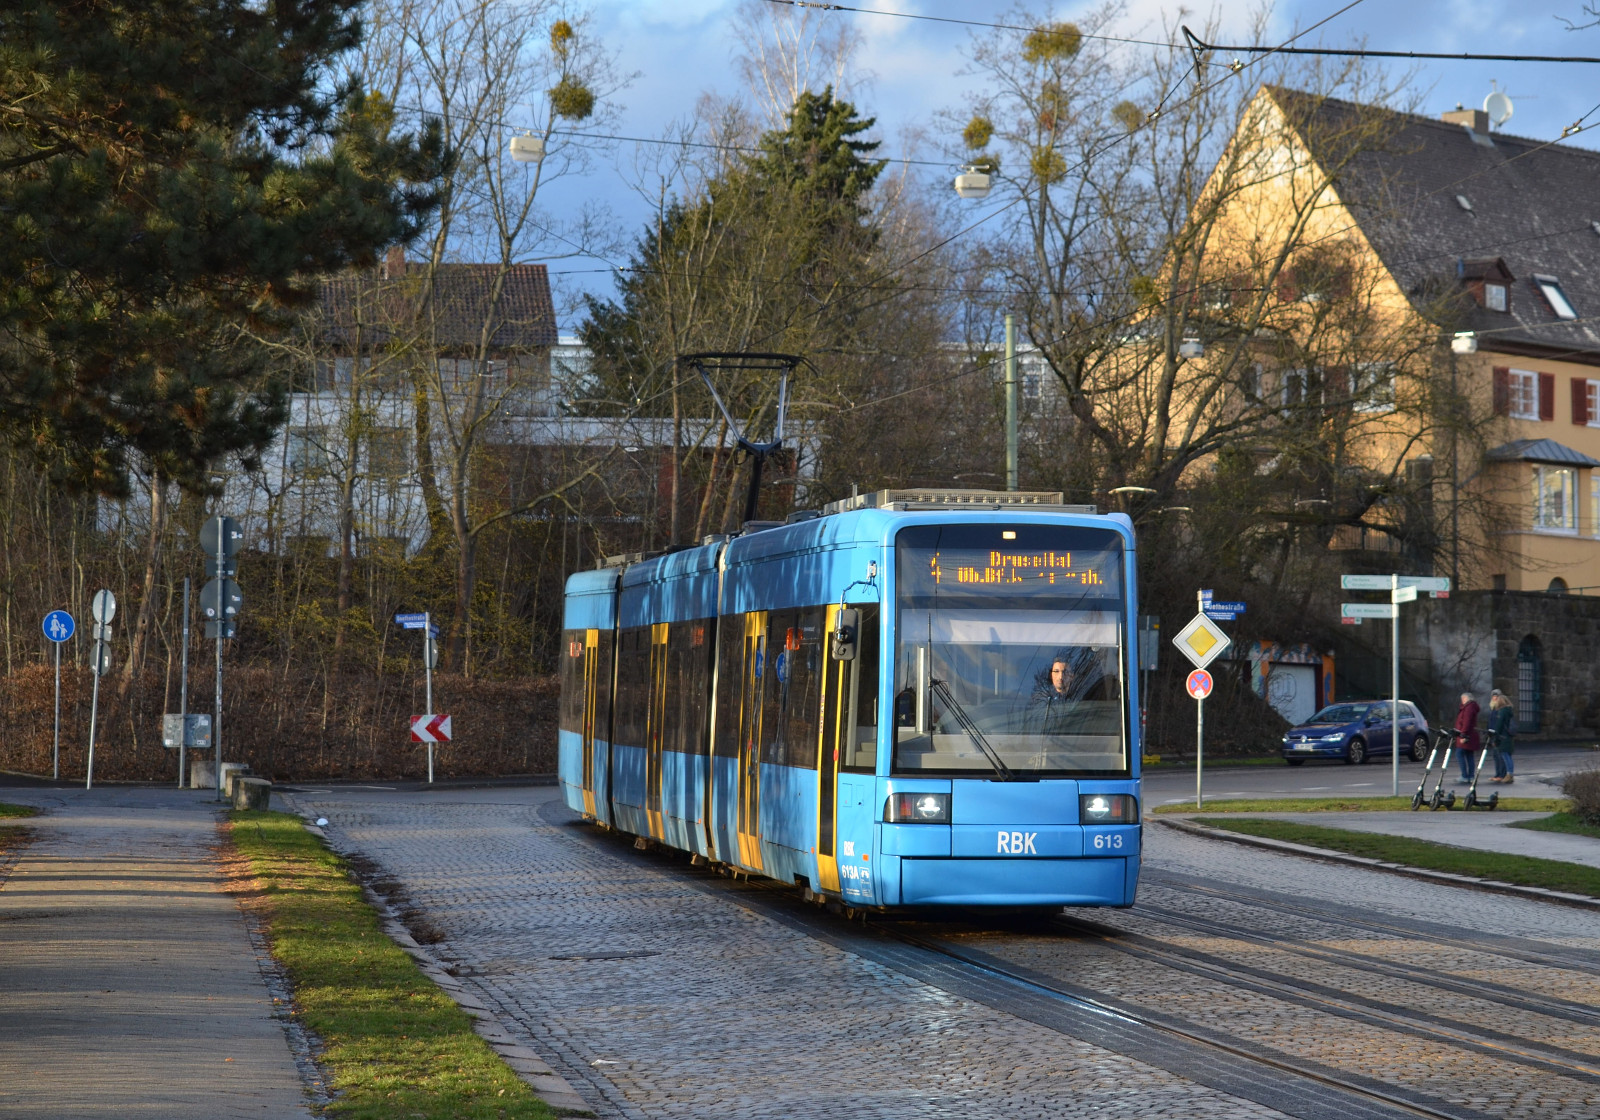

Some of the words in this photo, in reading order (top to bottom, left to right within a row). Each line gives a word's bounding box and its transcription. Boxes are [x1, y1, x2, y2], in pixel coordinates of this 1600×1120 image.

[990, 551, 1071, 567] Druseltal
[844, 841, 854, 856] RBK
[997, 831, 1038, 855] RBK
[1094, 834, 1123, 849] 613
[842, 865, 859, 879] 613A
